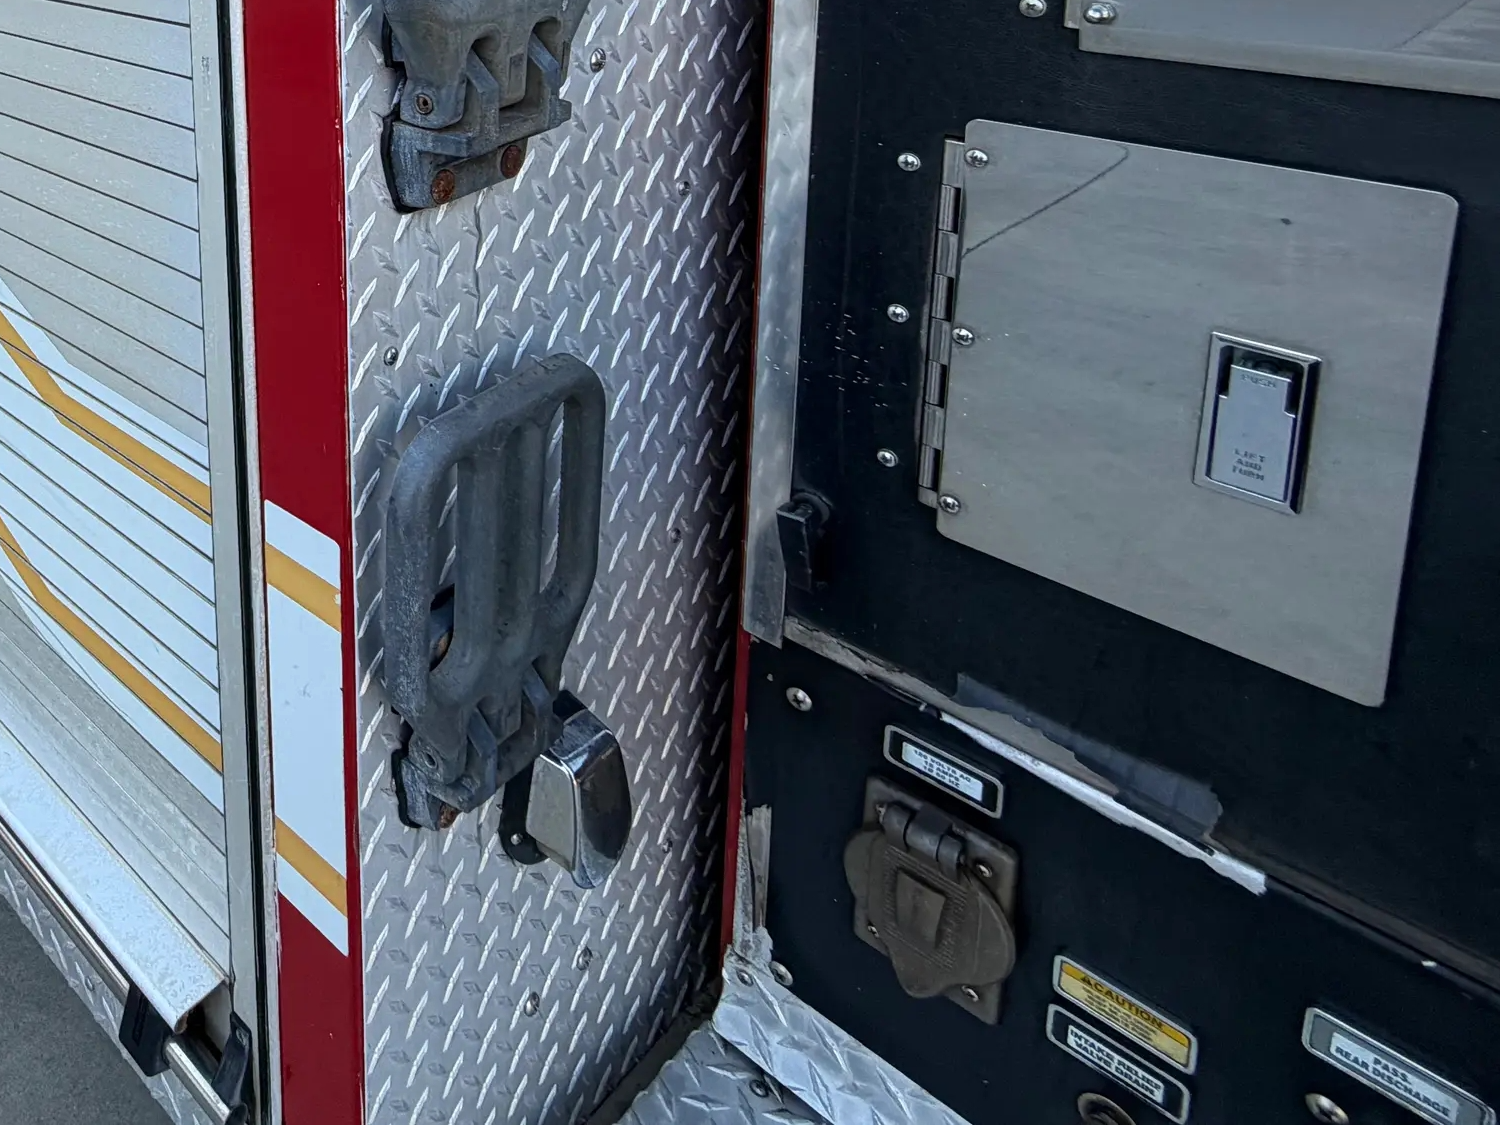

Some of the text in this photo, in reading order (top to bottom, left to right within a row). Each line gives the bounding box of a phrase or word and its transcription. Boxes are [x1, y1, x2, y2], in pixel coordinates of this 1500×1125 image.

[1241, 374, 1276, 389] PUSH
[1234, 448, 1265, 462] LIFT
[913, 749, 971, 783] 120 VOLTS AC
[936, 767, 960, 782] AMPS
[1094, 981, 1163, 1029] CAUTION
[1070, 1029, 1161, 1090] INTAKE RELIEF
[1074, 1040, 1156, 1096] VALVE DRAIN
[1335, 1046, 1451, 1116] REAR DISCHARGE
